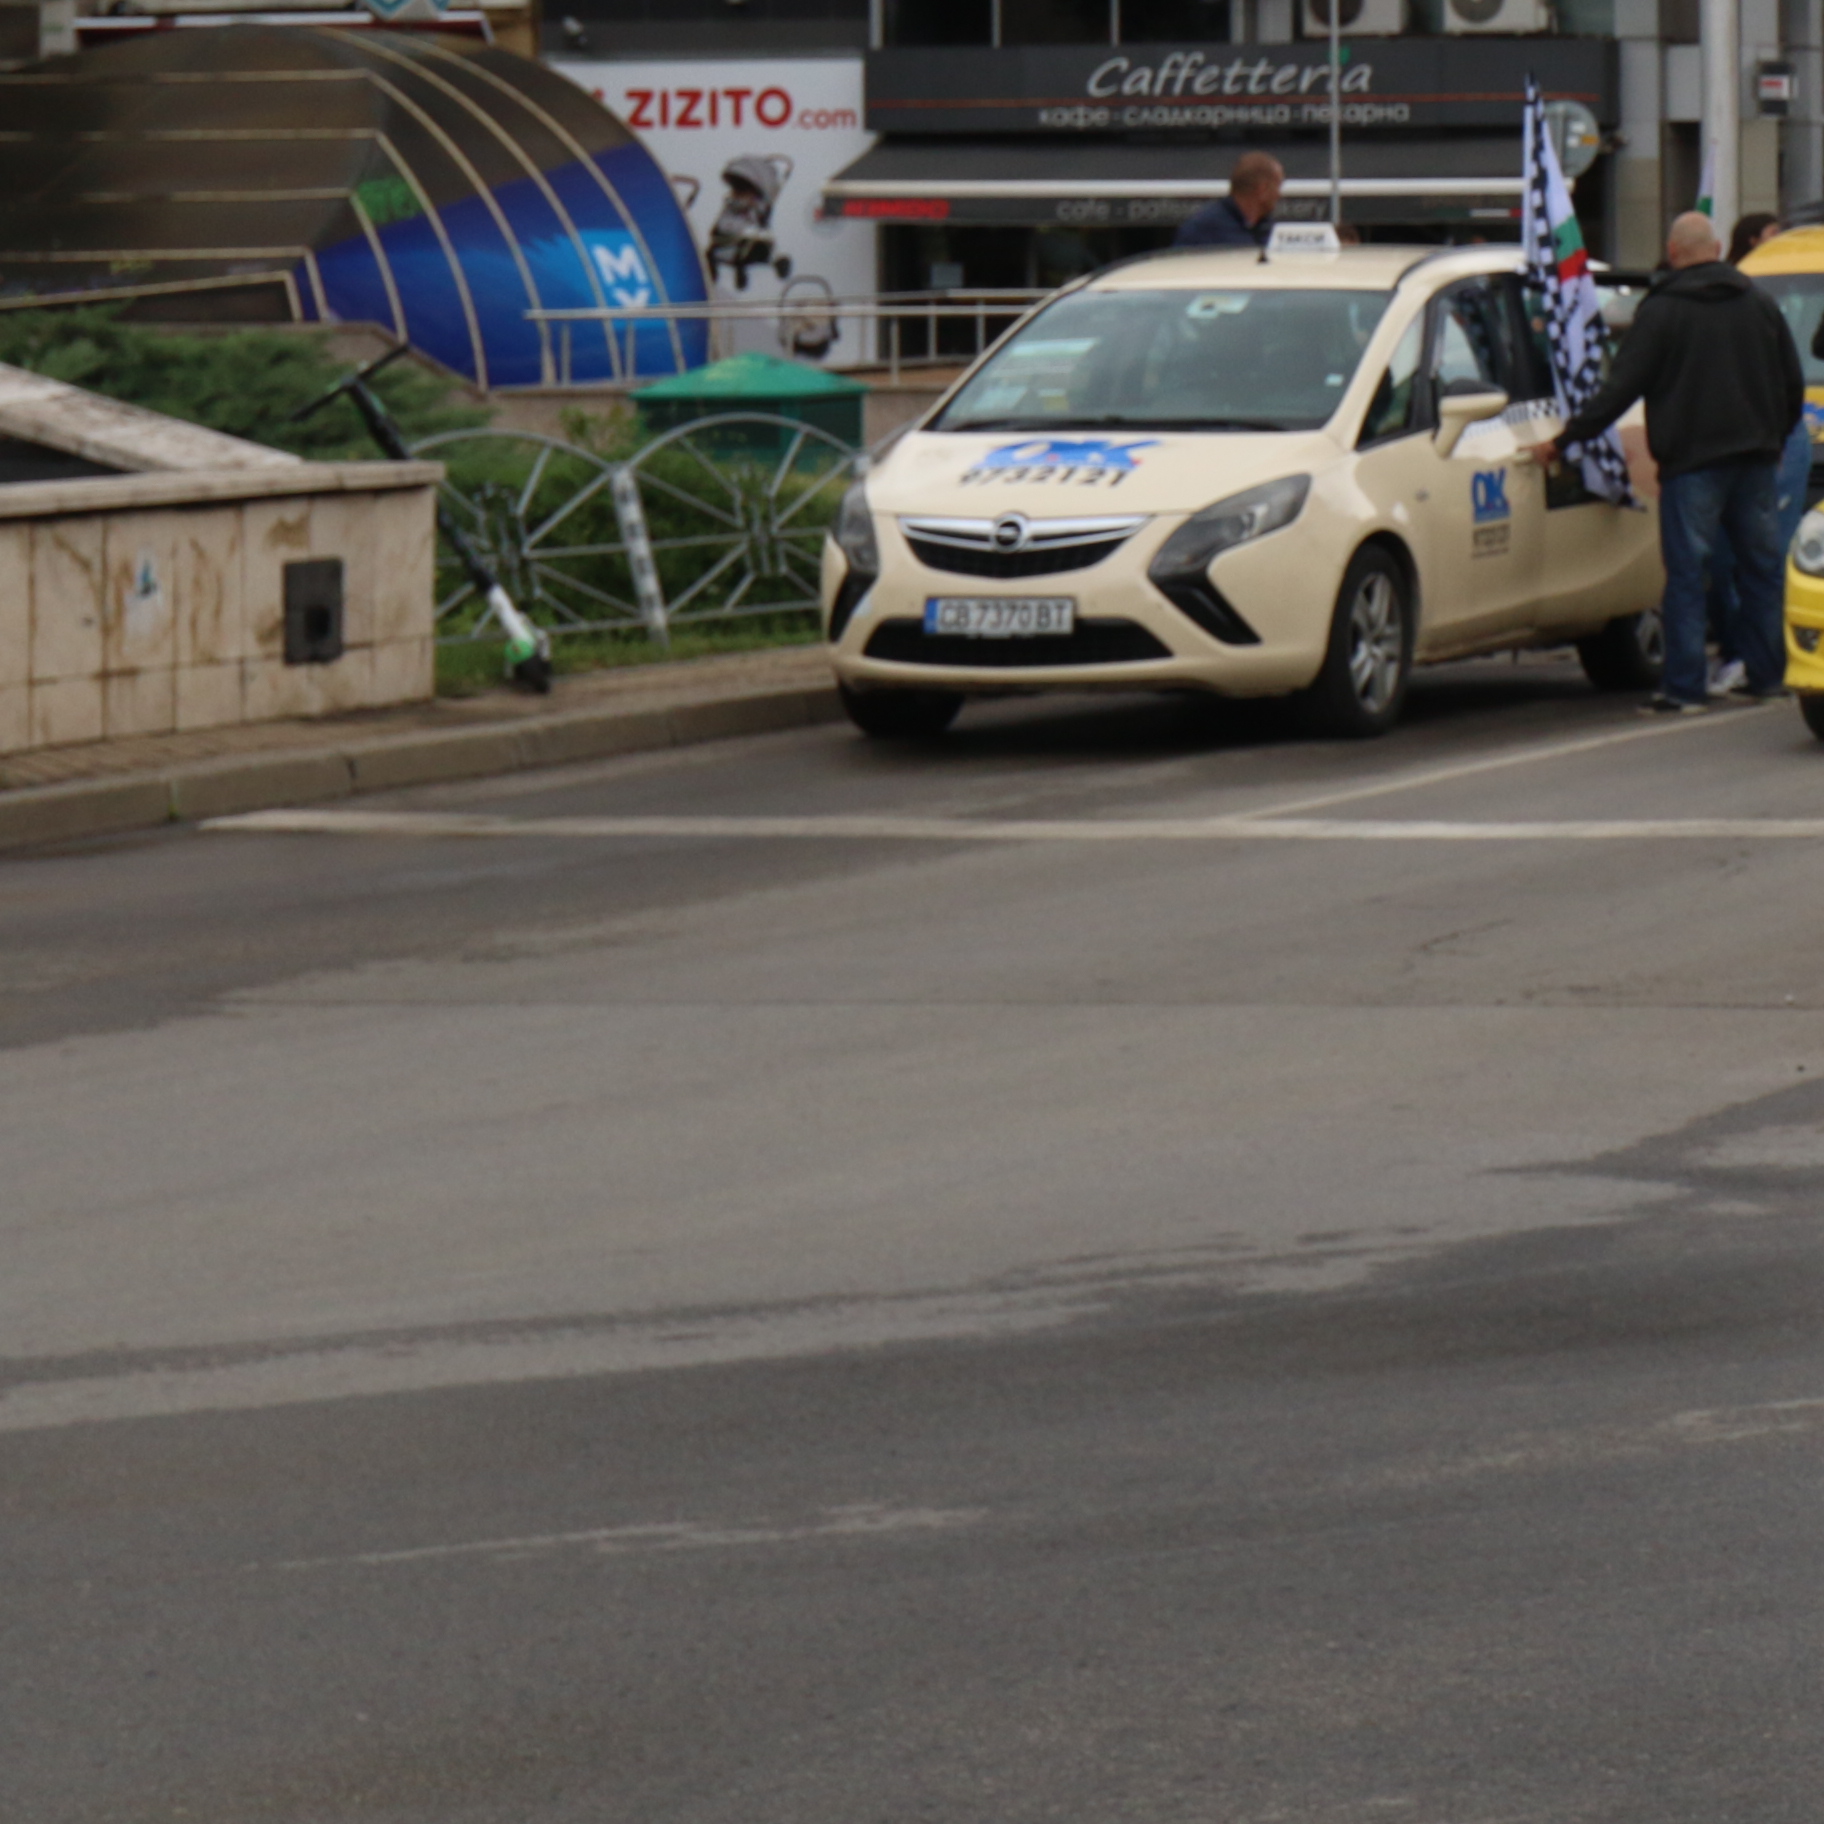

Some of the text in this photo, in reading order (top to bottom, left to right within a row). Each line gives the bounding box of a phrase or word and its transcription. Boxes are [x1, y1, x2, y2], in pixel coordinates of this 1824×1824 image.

[1038, 105, 1110, 129] кафе
[1123, 104, 1290, 130] сладкарница
[938, 599, 1069, 628] CB 7370 BT
